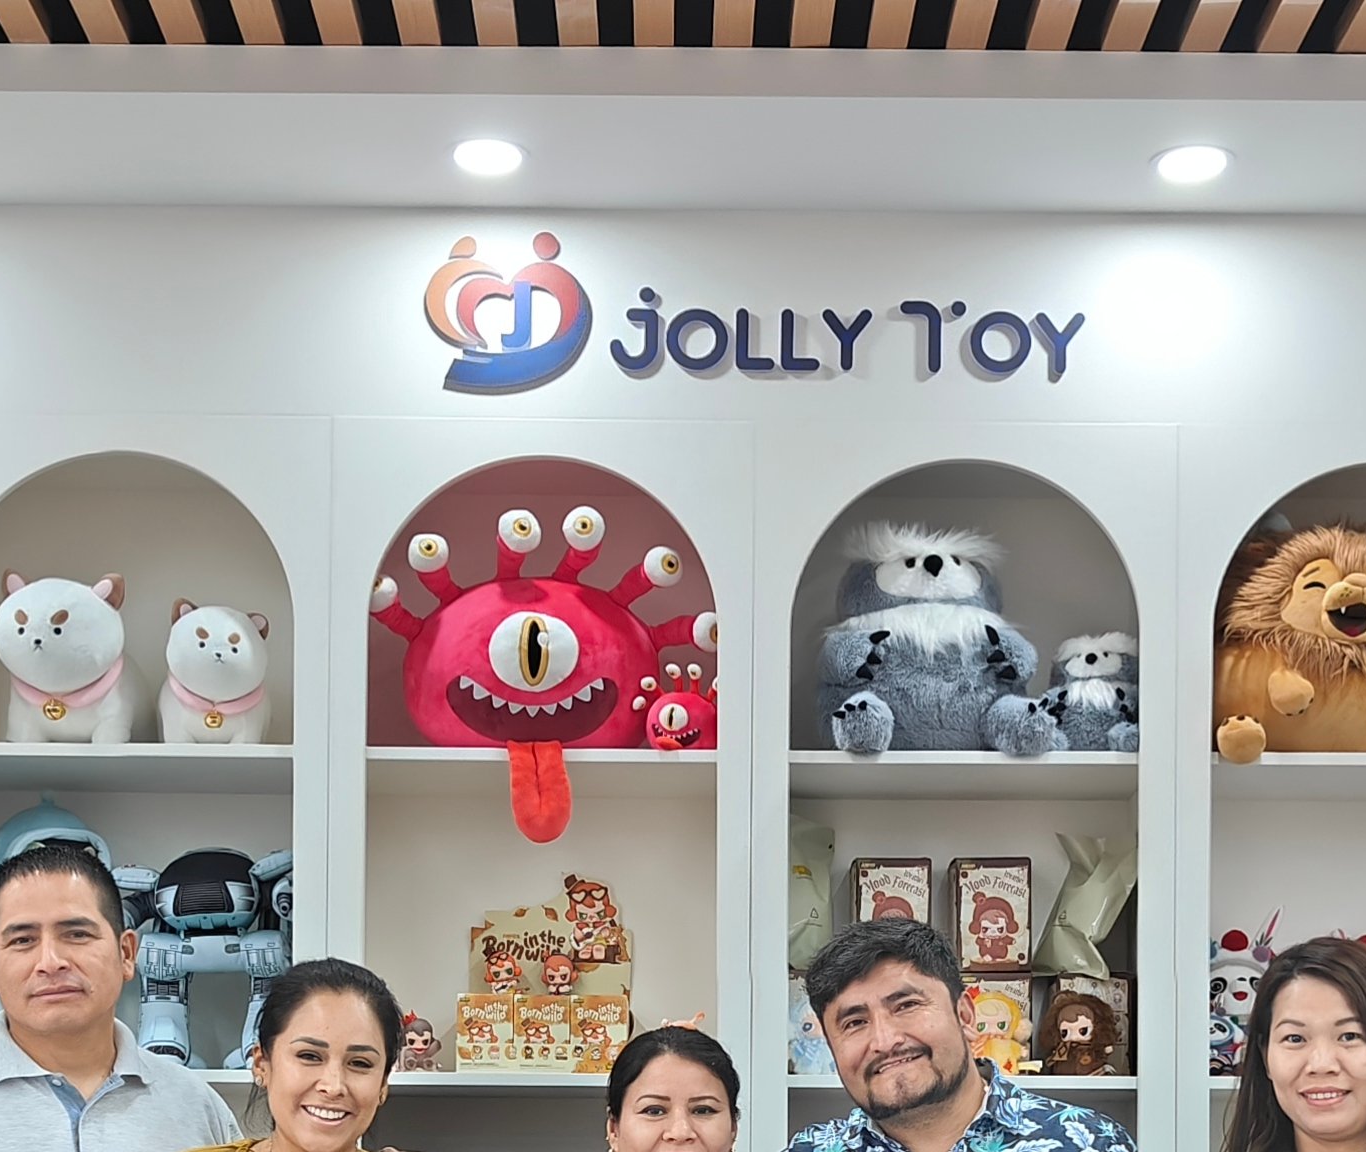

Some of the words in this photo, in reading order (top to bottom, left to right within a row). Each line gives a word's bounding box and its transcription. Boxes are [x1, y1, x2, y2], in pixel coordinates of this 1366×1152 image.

[900, 301, 1085, 374] TOY
[482, 936, 524, 960] Born
[524, 932, 539, 948] in
[539, 930, 566, 948] the
[462, 1006, 485, 1019] Born
[485, 1003, 493, 1012] in
[493, 1002, 508, 1012] the
[519, 1007, 542, 1020] Born
[542, 1004, 550, 1013] in
[550, 1003, 565, 1013] the
[576, 1007, 599, 1020] Born
[598, 1004, 606, 1013] in
[606, 1003, 622, 1014] the
